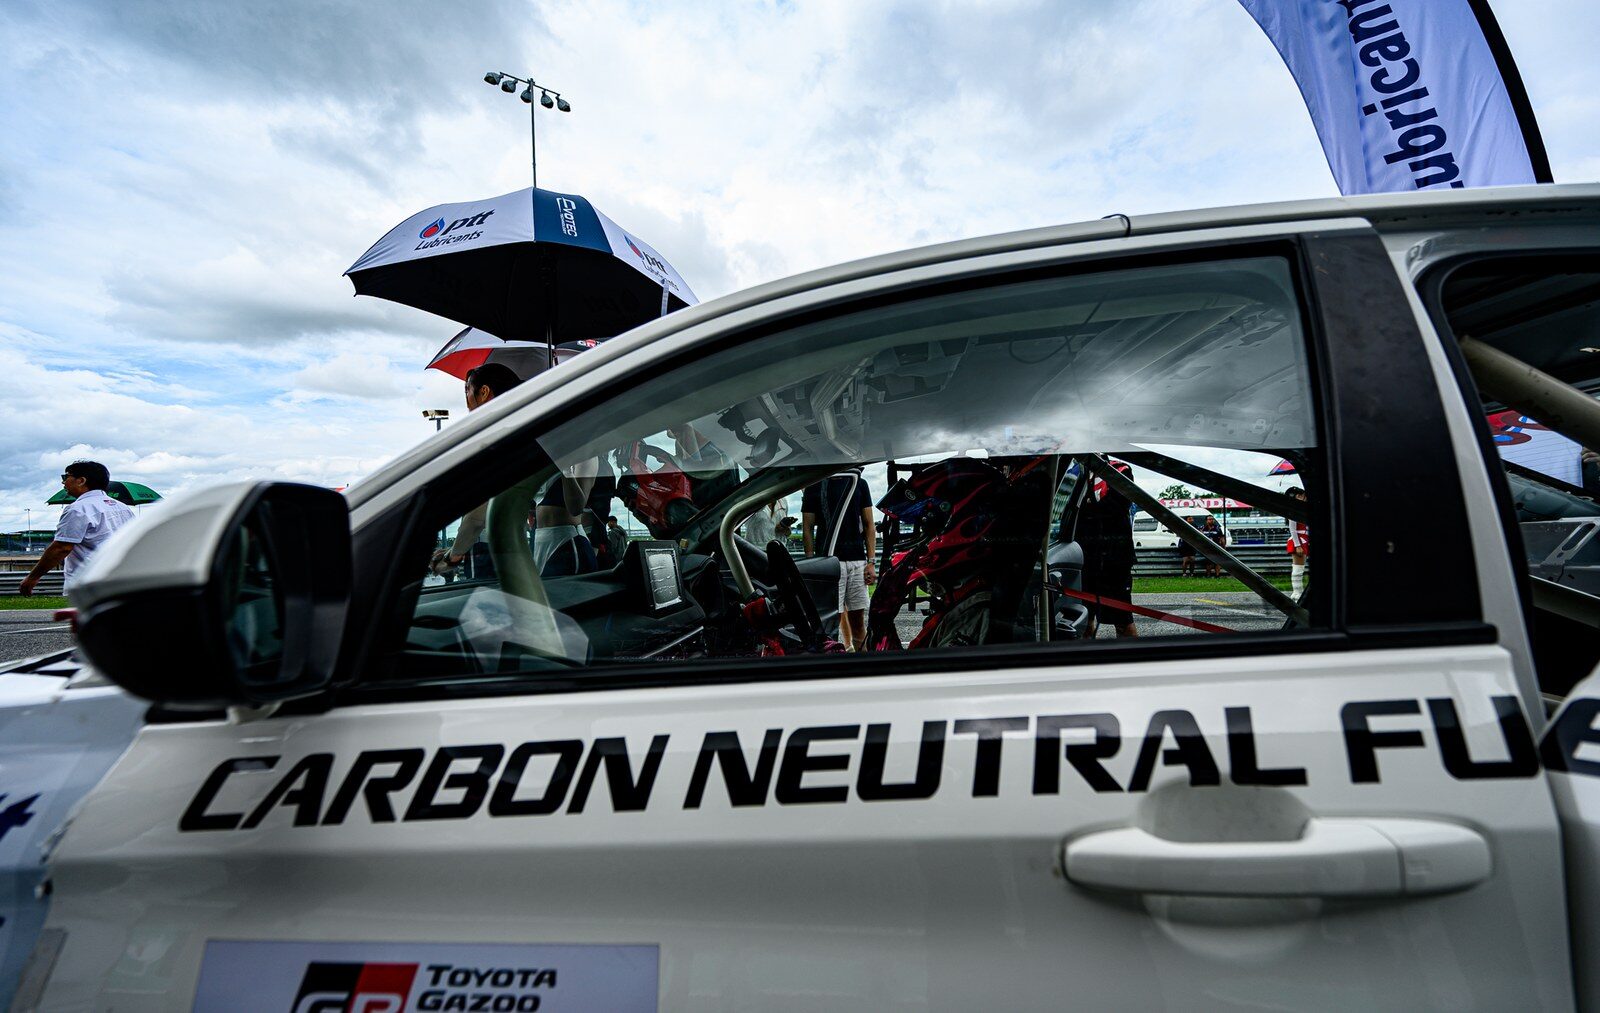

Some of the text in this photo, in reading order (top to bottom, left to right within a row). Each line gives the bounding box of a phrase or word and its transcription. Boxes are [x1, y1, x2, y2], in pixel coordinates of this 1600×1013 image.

[1336, 0, 1464, 188] ubrican
[440, 208, 496, 236] ptt
[414, 229, 484, 251] Lubricants
[1164, 498, 1239, 508] HONDA
[178, 734, 671, 832] CARBON
[682, 706, 1309, 810] NEUTRAL
[426, 964, 557, 989] TOYOTA
[416, 989, 541, 1013] GAZOO
